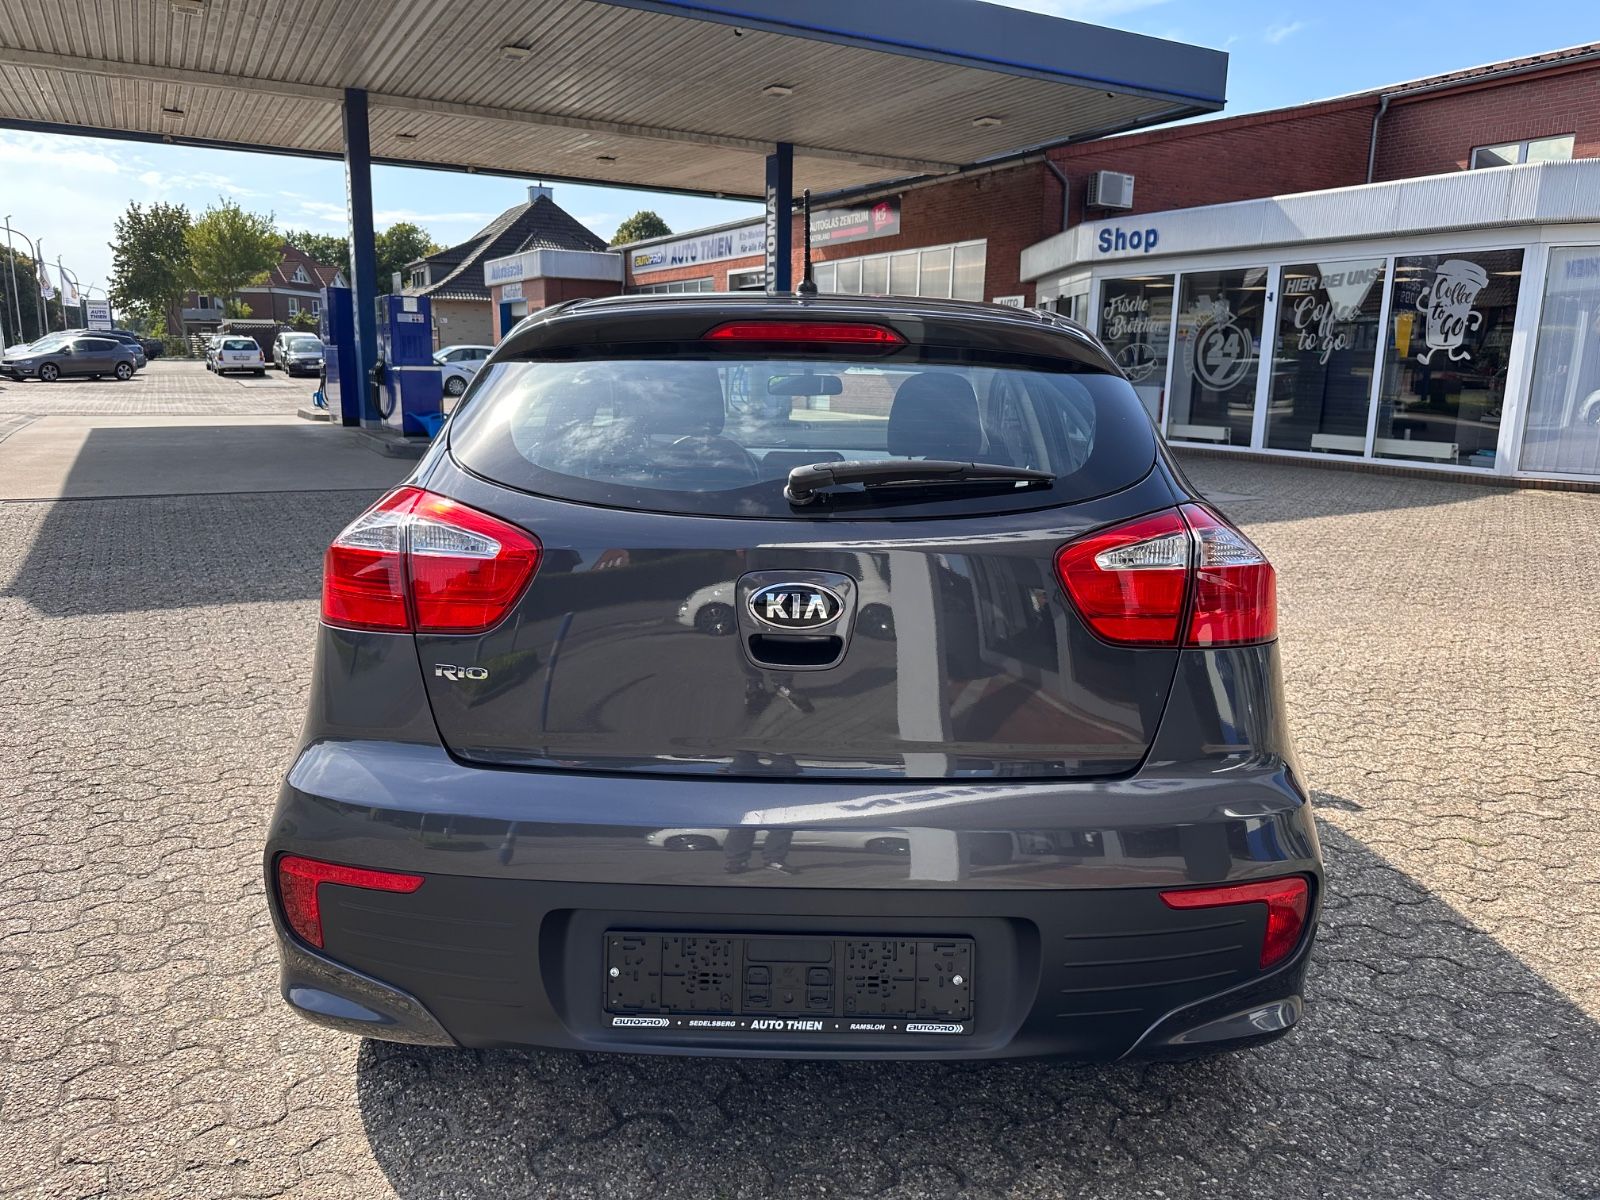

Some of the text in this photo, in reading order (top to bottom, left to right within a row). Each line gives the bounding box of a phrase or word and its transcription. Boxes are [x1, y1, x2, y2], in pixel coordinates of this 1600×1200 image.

[840, 210, 869, 227] ZENTRUM
[671, 236, 732, 265] AUTO THIEN
[1098, 227, 1160, 253] Shop
[1285, 267, 1379, 293] HIER BEI UNS
[1435, 277, 1471, 306] Coffee
[1104, 294, 1149, 320] Frische
[1294, 296, 1361, 338] Coffee
[1430, 302, 1445, 320] to
[1109, 315, 1162, 340] Brötchen
[1297, 328, 1318, 351] to
[1208, 333, 1240, 359] 24
[765, 592, 829, 620] KIA
[435, 663, 488, 681] RIO
[688, 1019, 736, 1027] SEDELSBERG
[751, 1020, 784, 1030] AUTO
[786, 1020, 823, 1031] THIEN
[849, 1023, 886, 1031] RAMSLOH
